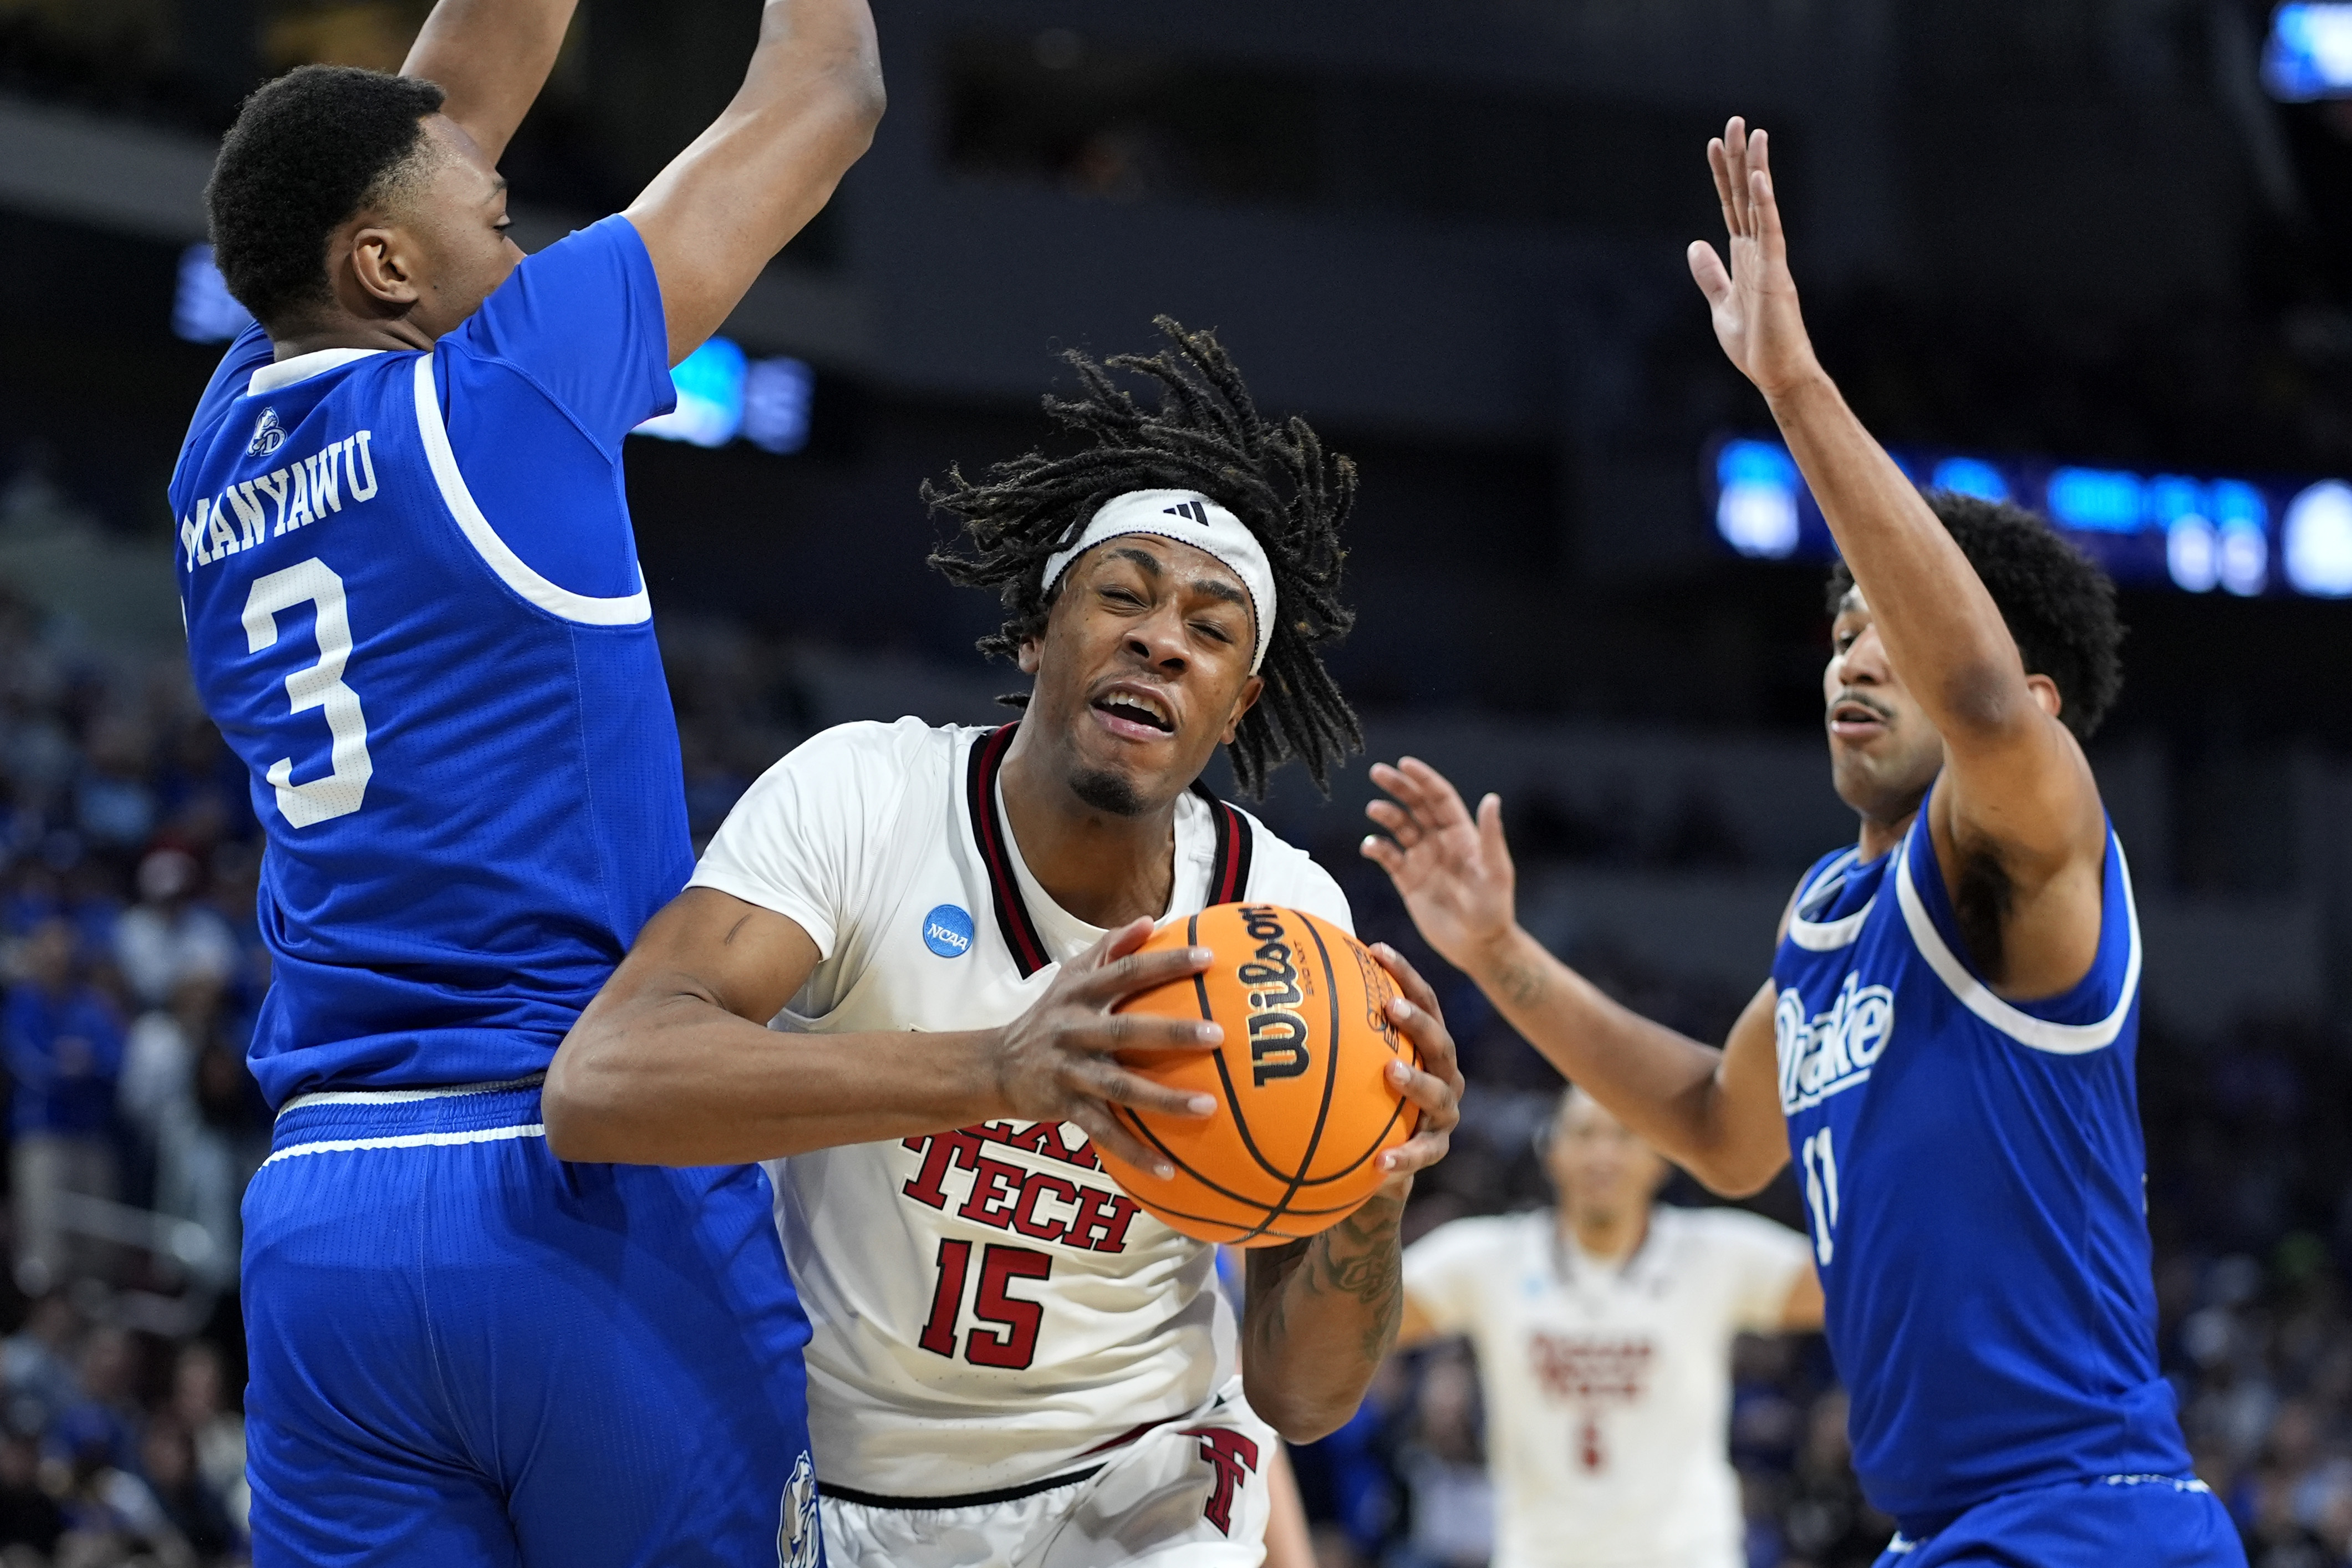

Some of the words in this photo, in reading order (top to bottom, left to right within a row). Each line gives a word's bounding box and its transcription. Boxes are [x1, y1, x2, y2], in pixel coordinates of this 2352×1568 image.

[180, 430, 378, 573] MANYAWU
[241, 557, 373, 829] 3
[927, 923, 968, 951] NCAA
[1236, 904, 1310, 1089] Wilson
[902, 1128, 1141, 1253] TECH
[918, 1238, 1053, 1370] 15
